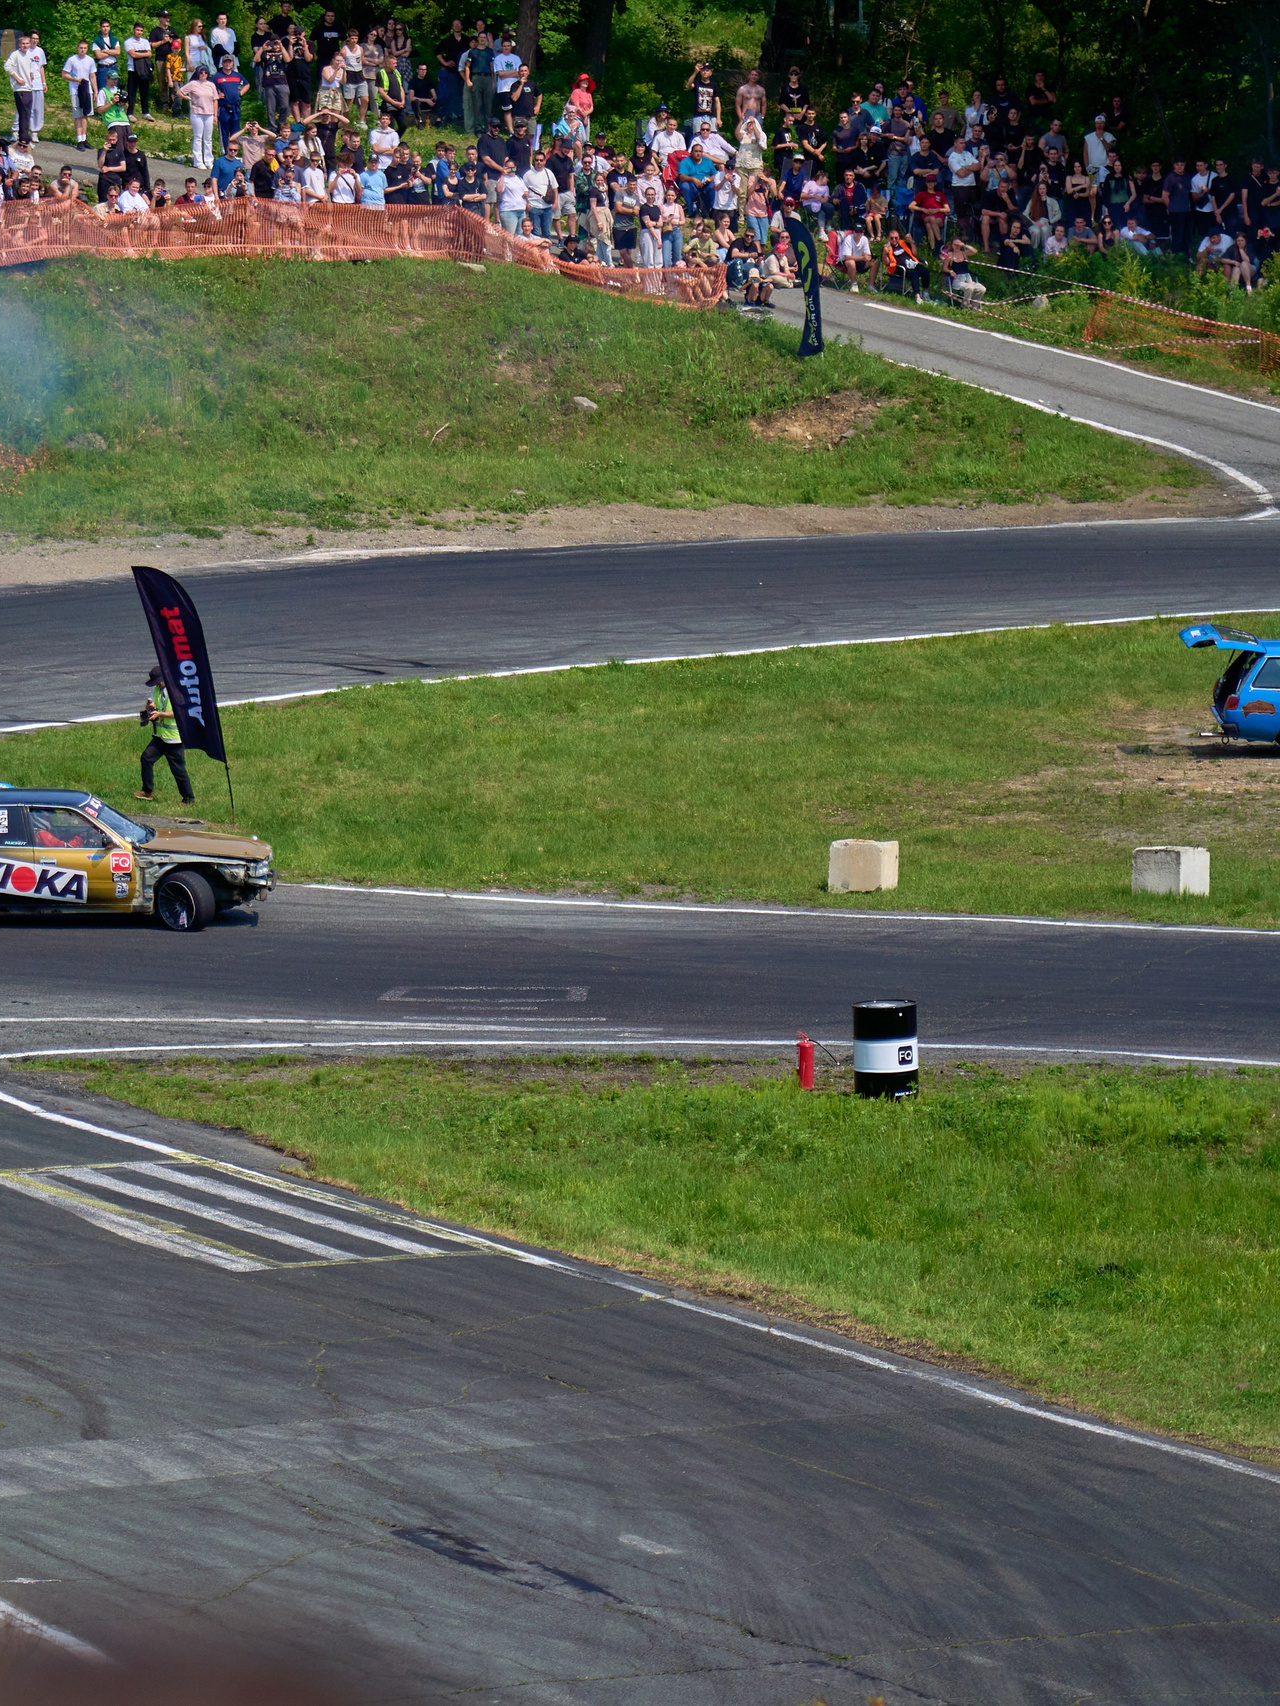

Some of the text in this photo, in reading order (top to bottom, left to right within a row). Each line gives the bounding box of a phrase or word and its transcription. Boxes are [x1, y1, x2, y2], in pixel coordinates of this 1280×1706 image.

[160, 606, 205, 728] Automat
[112, 857, 130, 868] FQ
[898, 1050, 913, 1062] FQ
